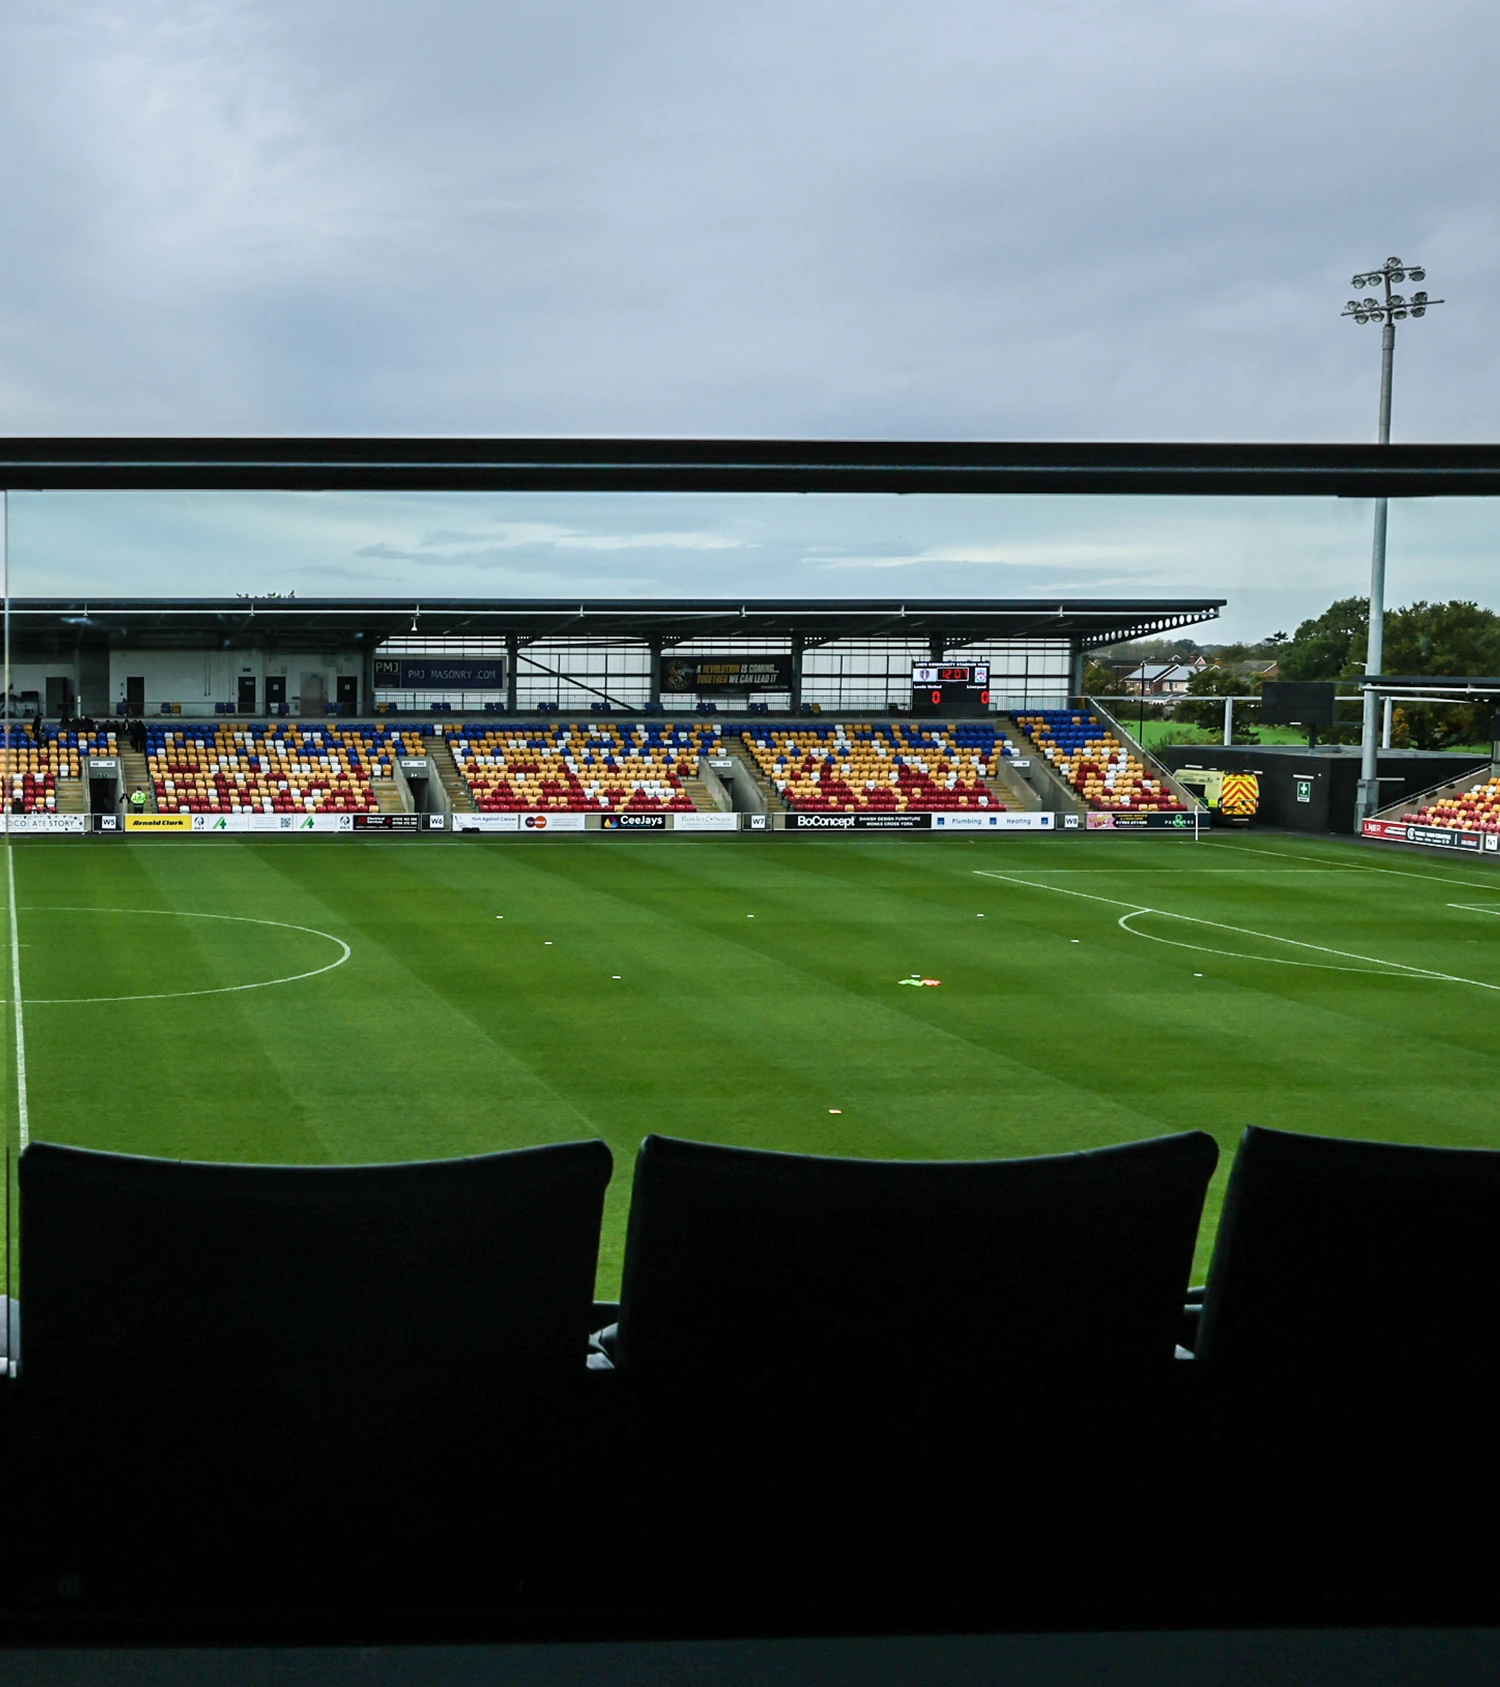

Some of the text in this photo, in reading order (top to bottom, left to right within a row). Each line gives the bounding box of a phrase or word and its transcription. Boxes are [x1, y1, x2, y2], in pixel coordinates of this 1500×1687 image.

[375, 662, 399, 673] PMJ
[408, 670, 425, 679] PMJ
[431, 670, 473, 679] MASONRY
[728, 675, 740, 684] WE
[739, 675, 754, 684] CAN
[753, 675, 770, 684] LEAD
[620, 815, 663, 827] CeeJays
[797, 816, 855, 828] BoConcept
[1364, 823, 1382, 833] LNER
